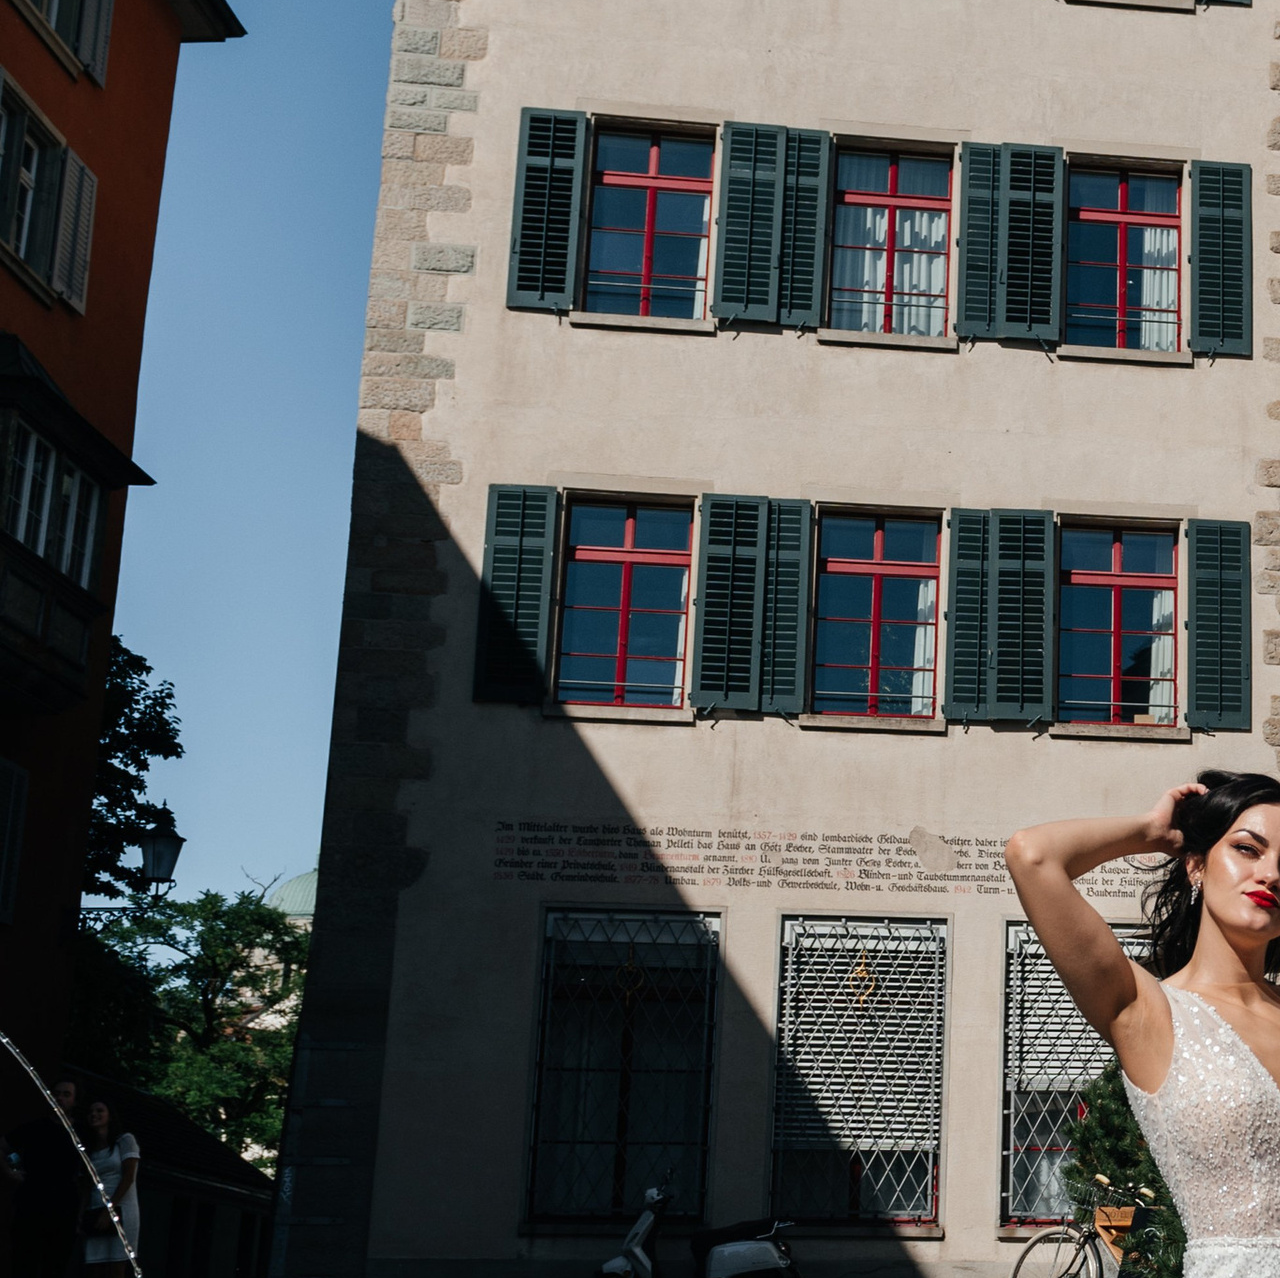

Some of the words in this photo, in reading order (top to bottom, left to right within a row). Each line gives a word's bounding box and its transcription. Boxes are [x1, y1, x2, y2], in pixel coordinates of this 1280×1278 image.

[519, 822, 568, 832] Mittelalter
[572, 824, 598, 834] wurde
[602, 825, 620, 834] dies
[623, 825, 647, 835] Haus
[650, 827, 663, 836] als
[666, 827, 712, 838] Wohnturm
[801, 832, 818, 841] sind
[822, 832, 873, 843] lombardische
[975, 838, 998, 847] daher
[521, 836, 555, 845] verkauft
[559, 836, 573, 845] der
[697, 840, 713, 849] das
[717, 840, 741, 850] Haus
[745, 843, 757, 851] an
[818, 844, 874, 854] Stammvater
[878, 846, 891, 855] der
[517, 847, 530, 856] bis
[619, 851, 639, 860] dann
[704, 854, 738, 863] genannt.
[803, 858, 820, 866] vom
[825, 857, 852, 867] Junker
[975, 863, 989, 871] von
[537, 859, 559, 869] einer
[640, 862, 704, 874] Blindenanstalt
[707, 865, 720, 875] der
[722, 865, 755, 876] Zürcher
[917, 871, 1006, 883] Taubstummenanstalt
[1102, 878, 1114, 886] der
[664, 876, 699, 886] Umbau.
[702, 878, 721, 887] 1879
[778, 879, 841, 891] Gewerbeschule,
[1086, 887, 1136, 898] Baudenkmal
